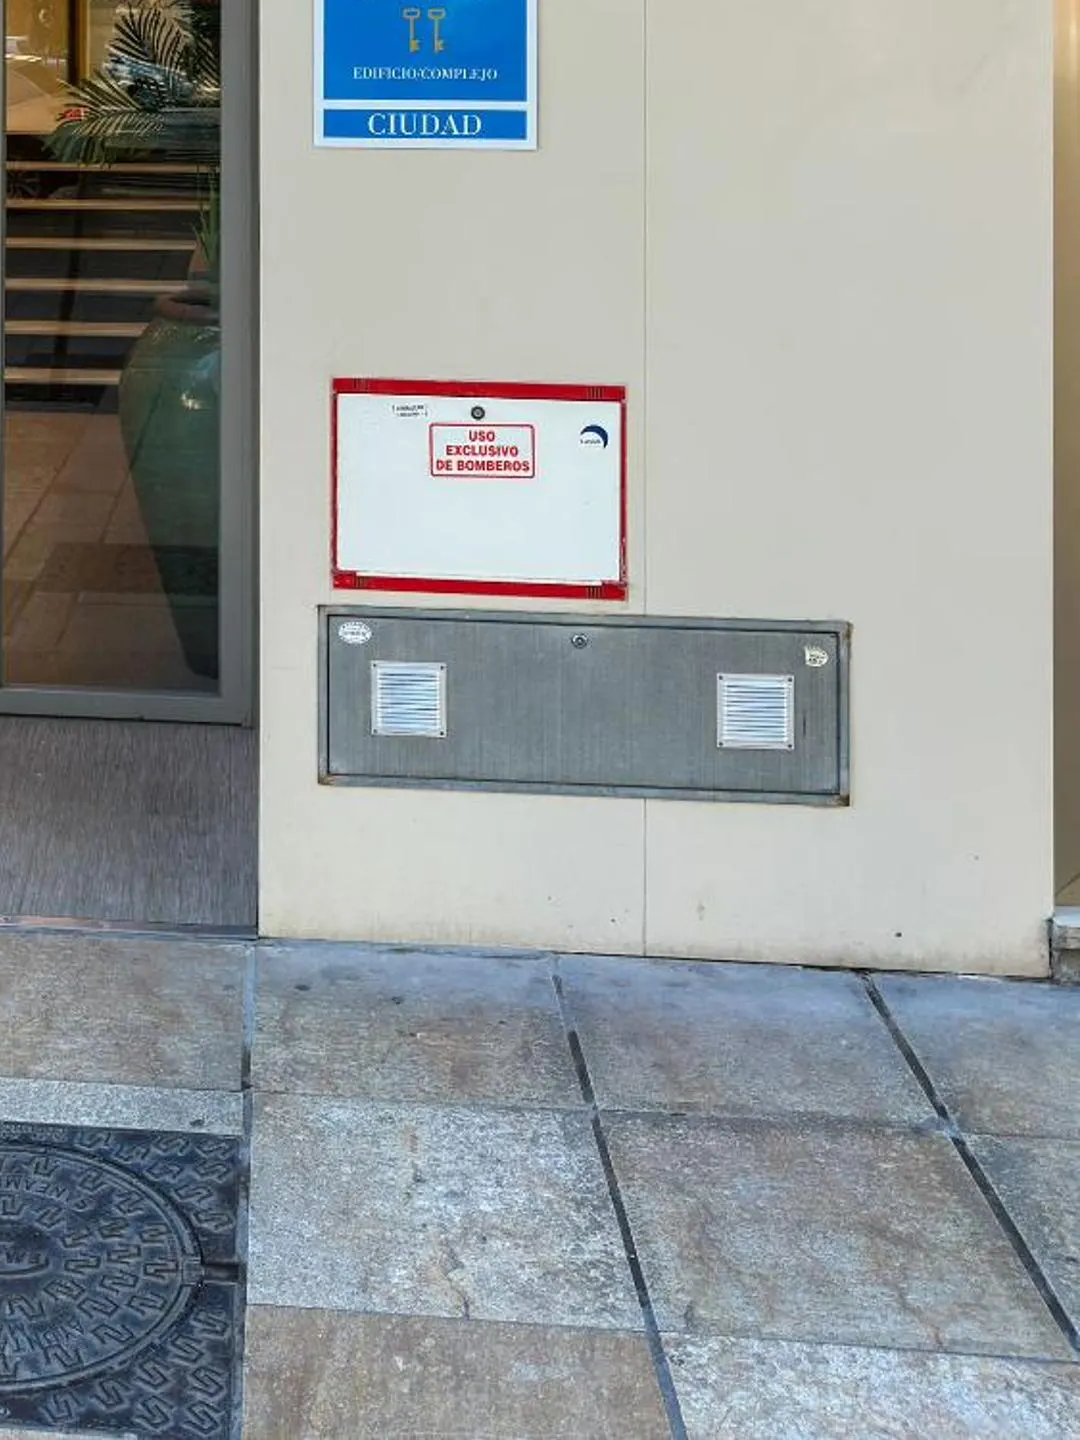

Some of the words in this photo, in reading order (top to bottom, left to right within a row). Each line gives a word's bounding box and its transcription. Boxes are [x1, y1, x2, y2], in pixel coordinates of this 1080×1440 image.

[368, 112, 482, 136] CIUDAD
[468, 429, 496, 442] USO
[445, 444, 519, 457] EXCLUSIVO
[435, 459, 453, 471] DE
[456, 460, 530, 473] BOMBEROS
